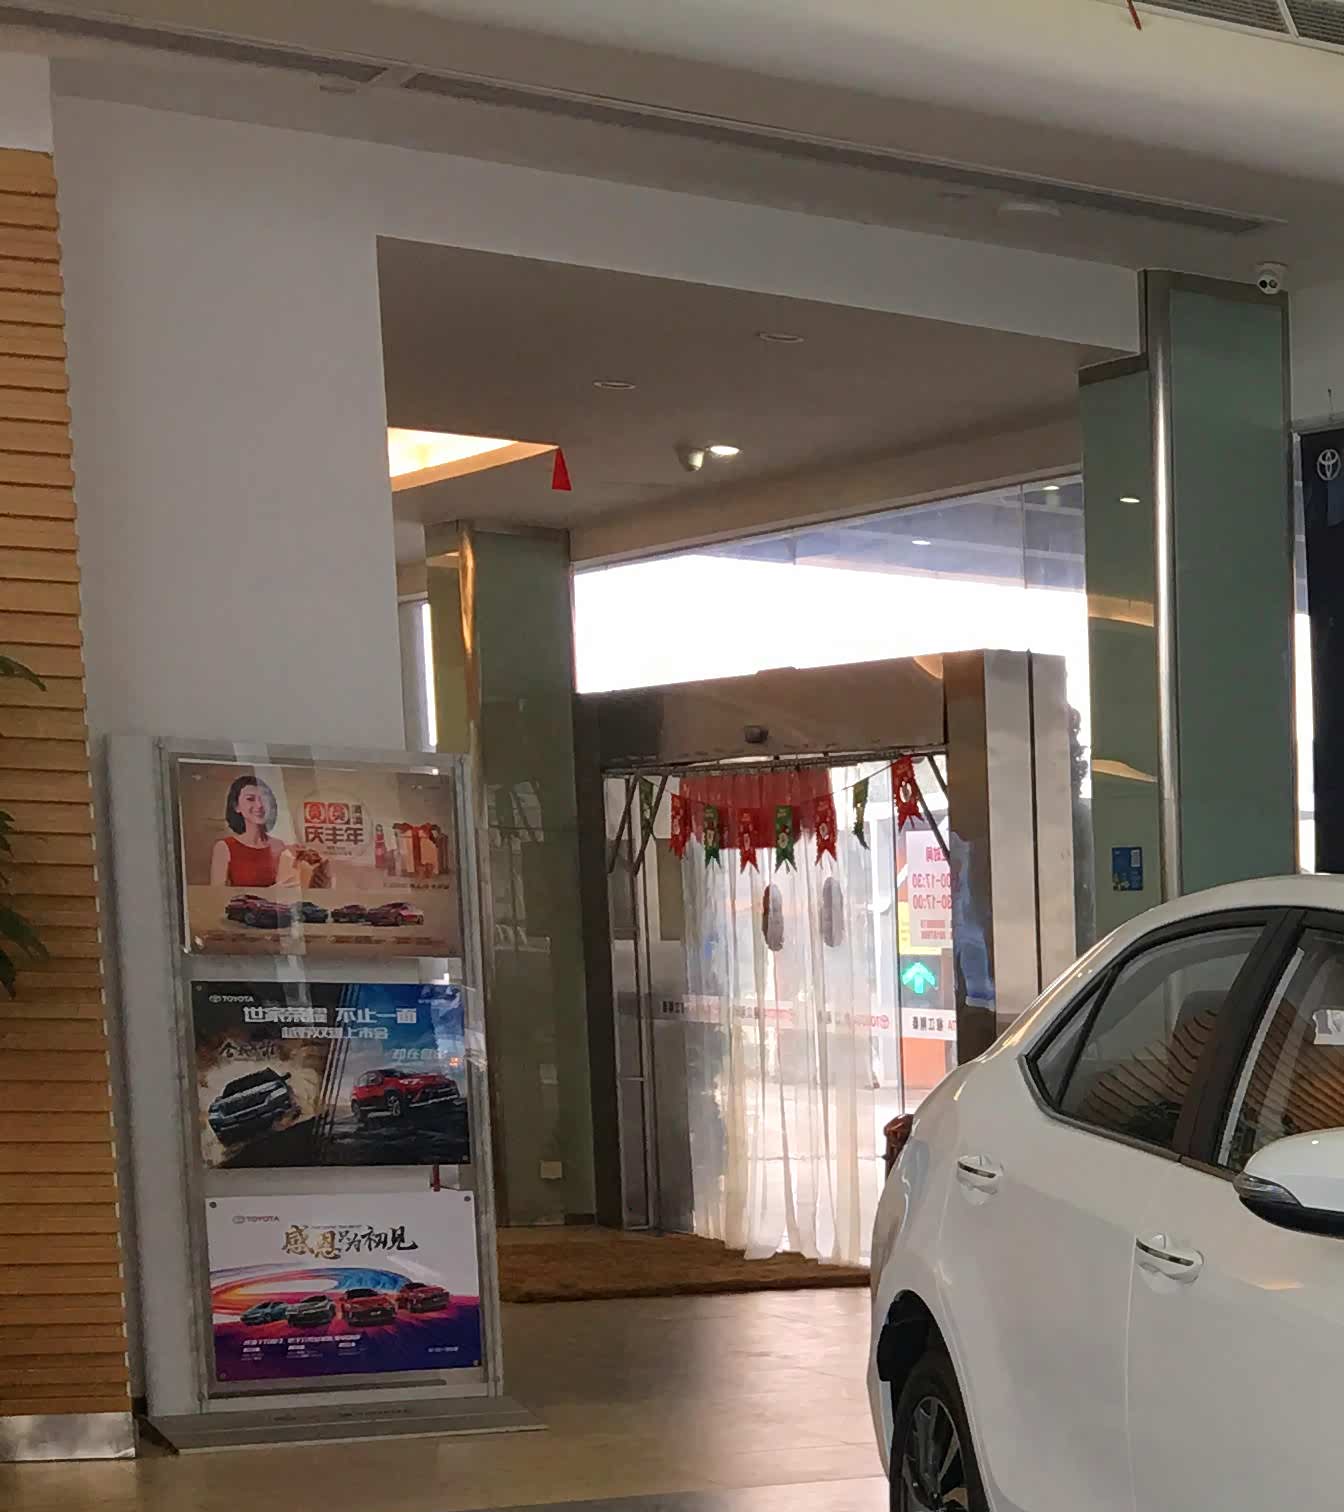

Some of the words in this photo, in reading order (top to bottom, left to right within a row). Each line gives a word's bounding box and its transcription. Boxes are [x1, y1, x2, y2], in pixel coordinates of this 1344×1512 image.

[304, 826, 364, 845] 庆丰年
[335, 1007, 417, 1024] 不止一面
[246, 1215, 280, 1223] TOYOTA
[281, 1224, 418, 1260] 感恩只为初见
